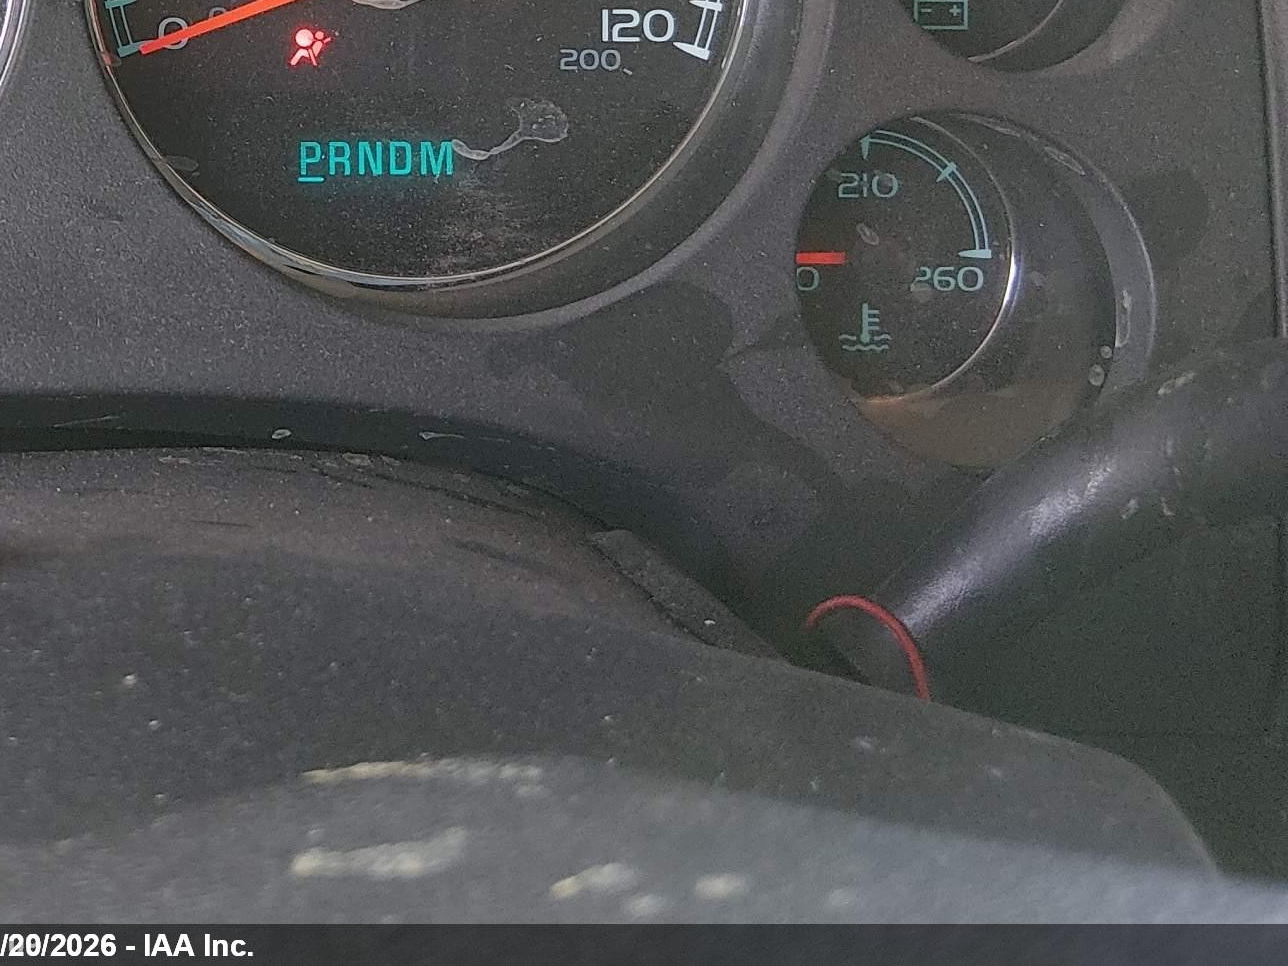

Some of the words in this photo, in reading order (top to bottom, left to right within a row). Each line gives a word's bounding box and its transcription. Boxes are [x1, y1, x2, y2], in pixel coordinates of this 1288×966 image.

[601, 9, 675, 42] 120
[559, 49, 621, 70] 200
[838, 172, 899, 198] 210
[913, 265, 984, 292] 260
